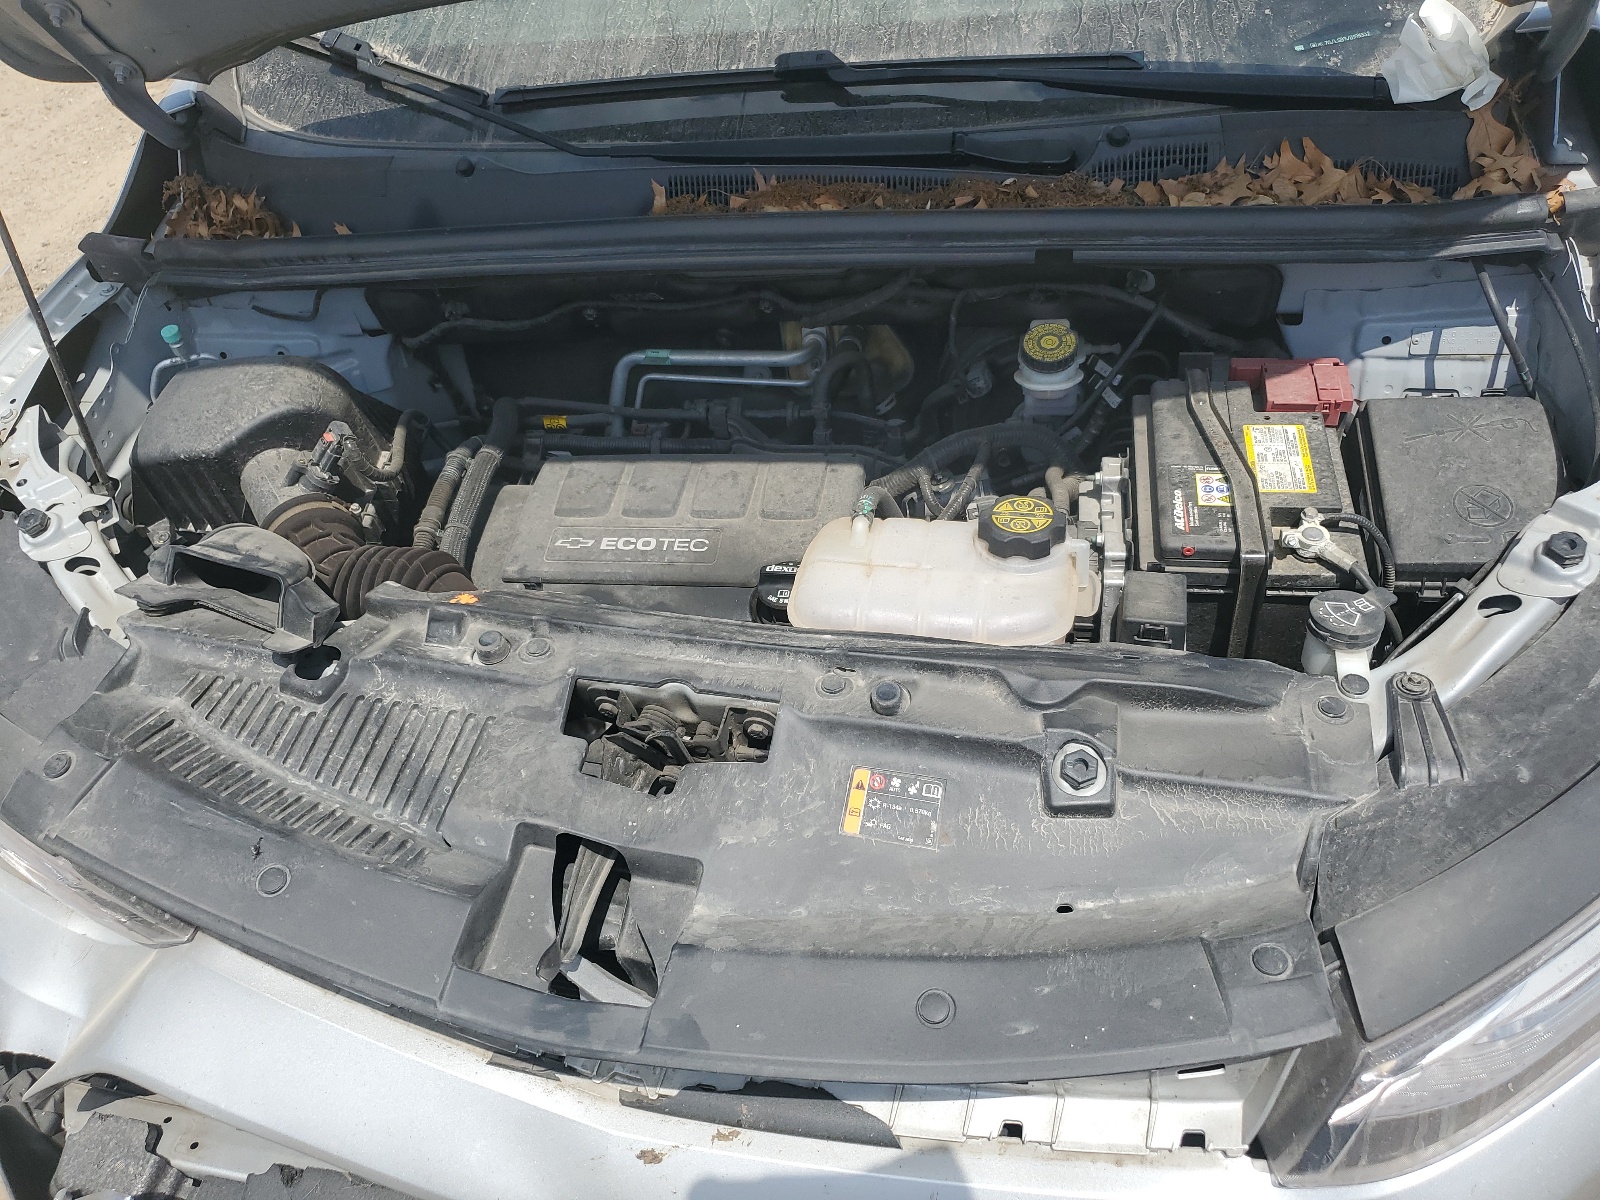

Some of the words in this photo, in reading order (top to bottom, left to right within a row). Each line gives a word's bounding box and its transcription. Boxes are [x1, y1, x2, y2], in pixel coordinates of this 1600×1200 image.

[1173, 490, 1185, 531] ACDelco
[600, 537, 710, 552] ECOTEC
[765, 564, 798, 573] dexo
